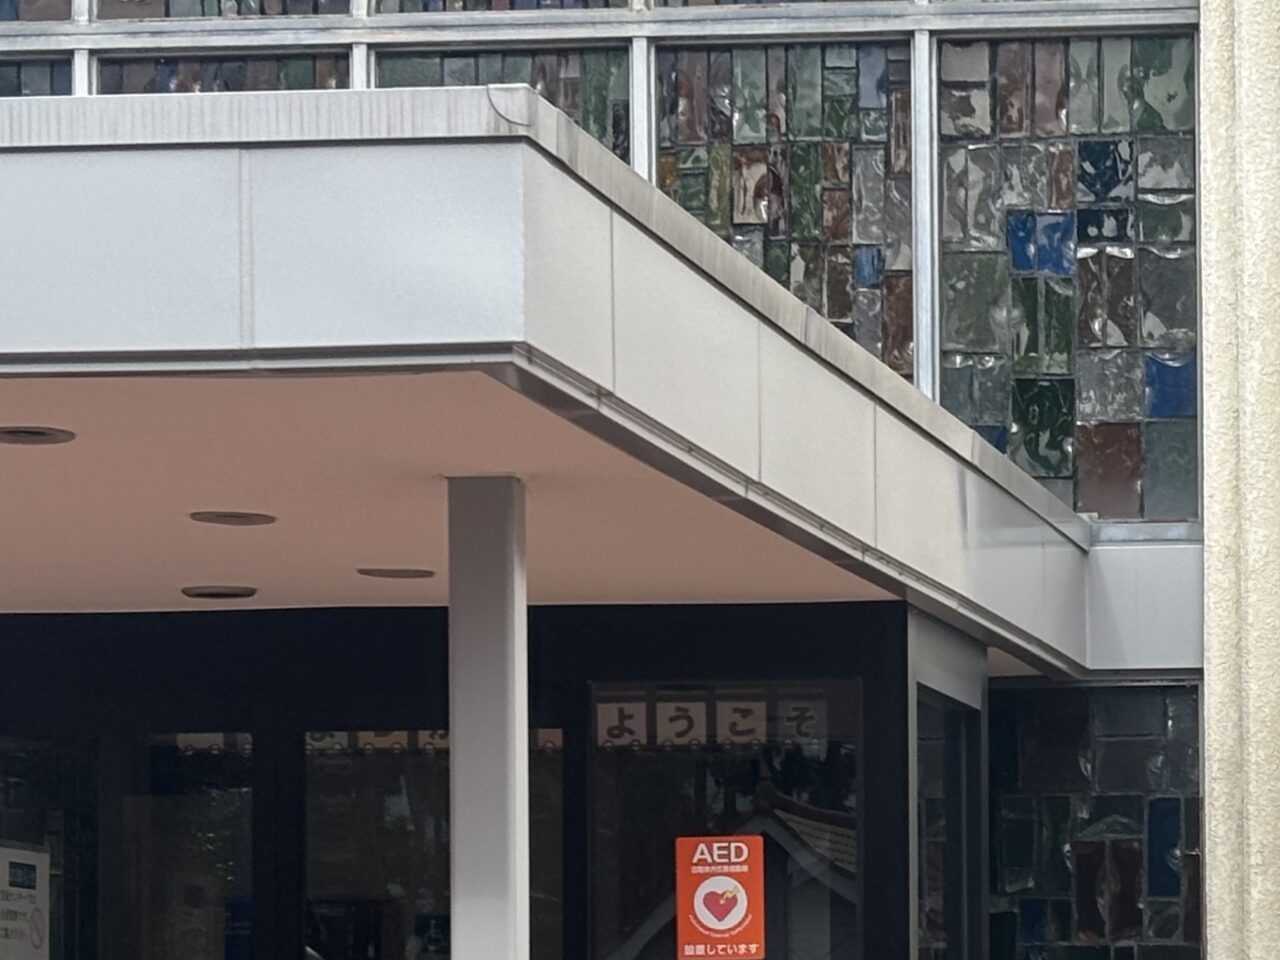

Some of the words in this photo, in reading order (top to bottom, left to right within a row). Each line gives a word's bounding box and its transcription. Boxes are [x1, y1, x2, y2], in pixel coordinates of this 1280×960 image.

[606, 705, 816, 740] ようこそ
[692, 842, 749, 863] AED
